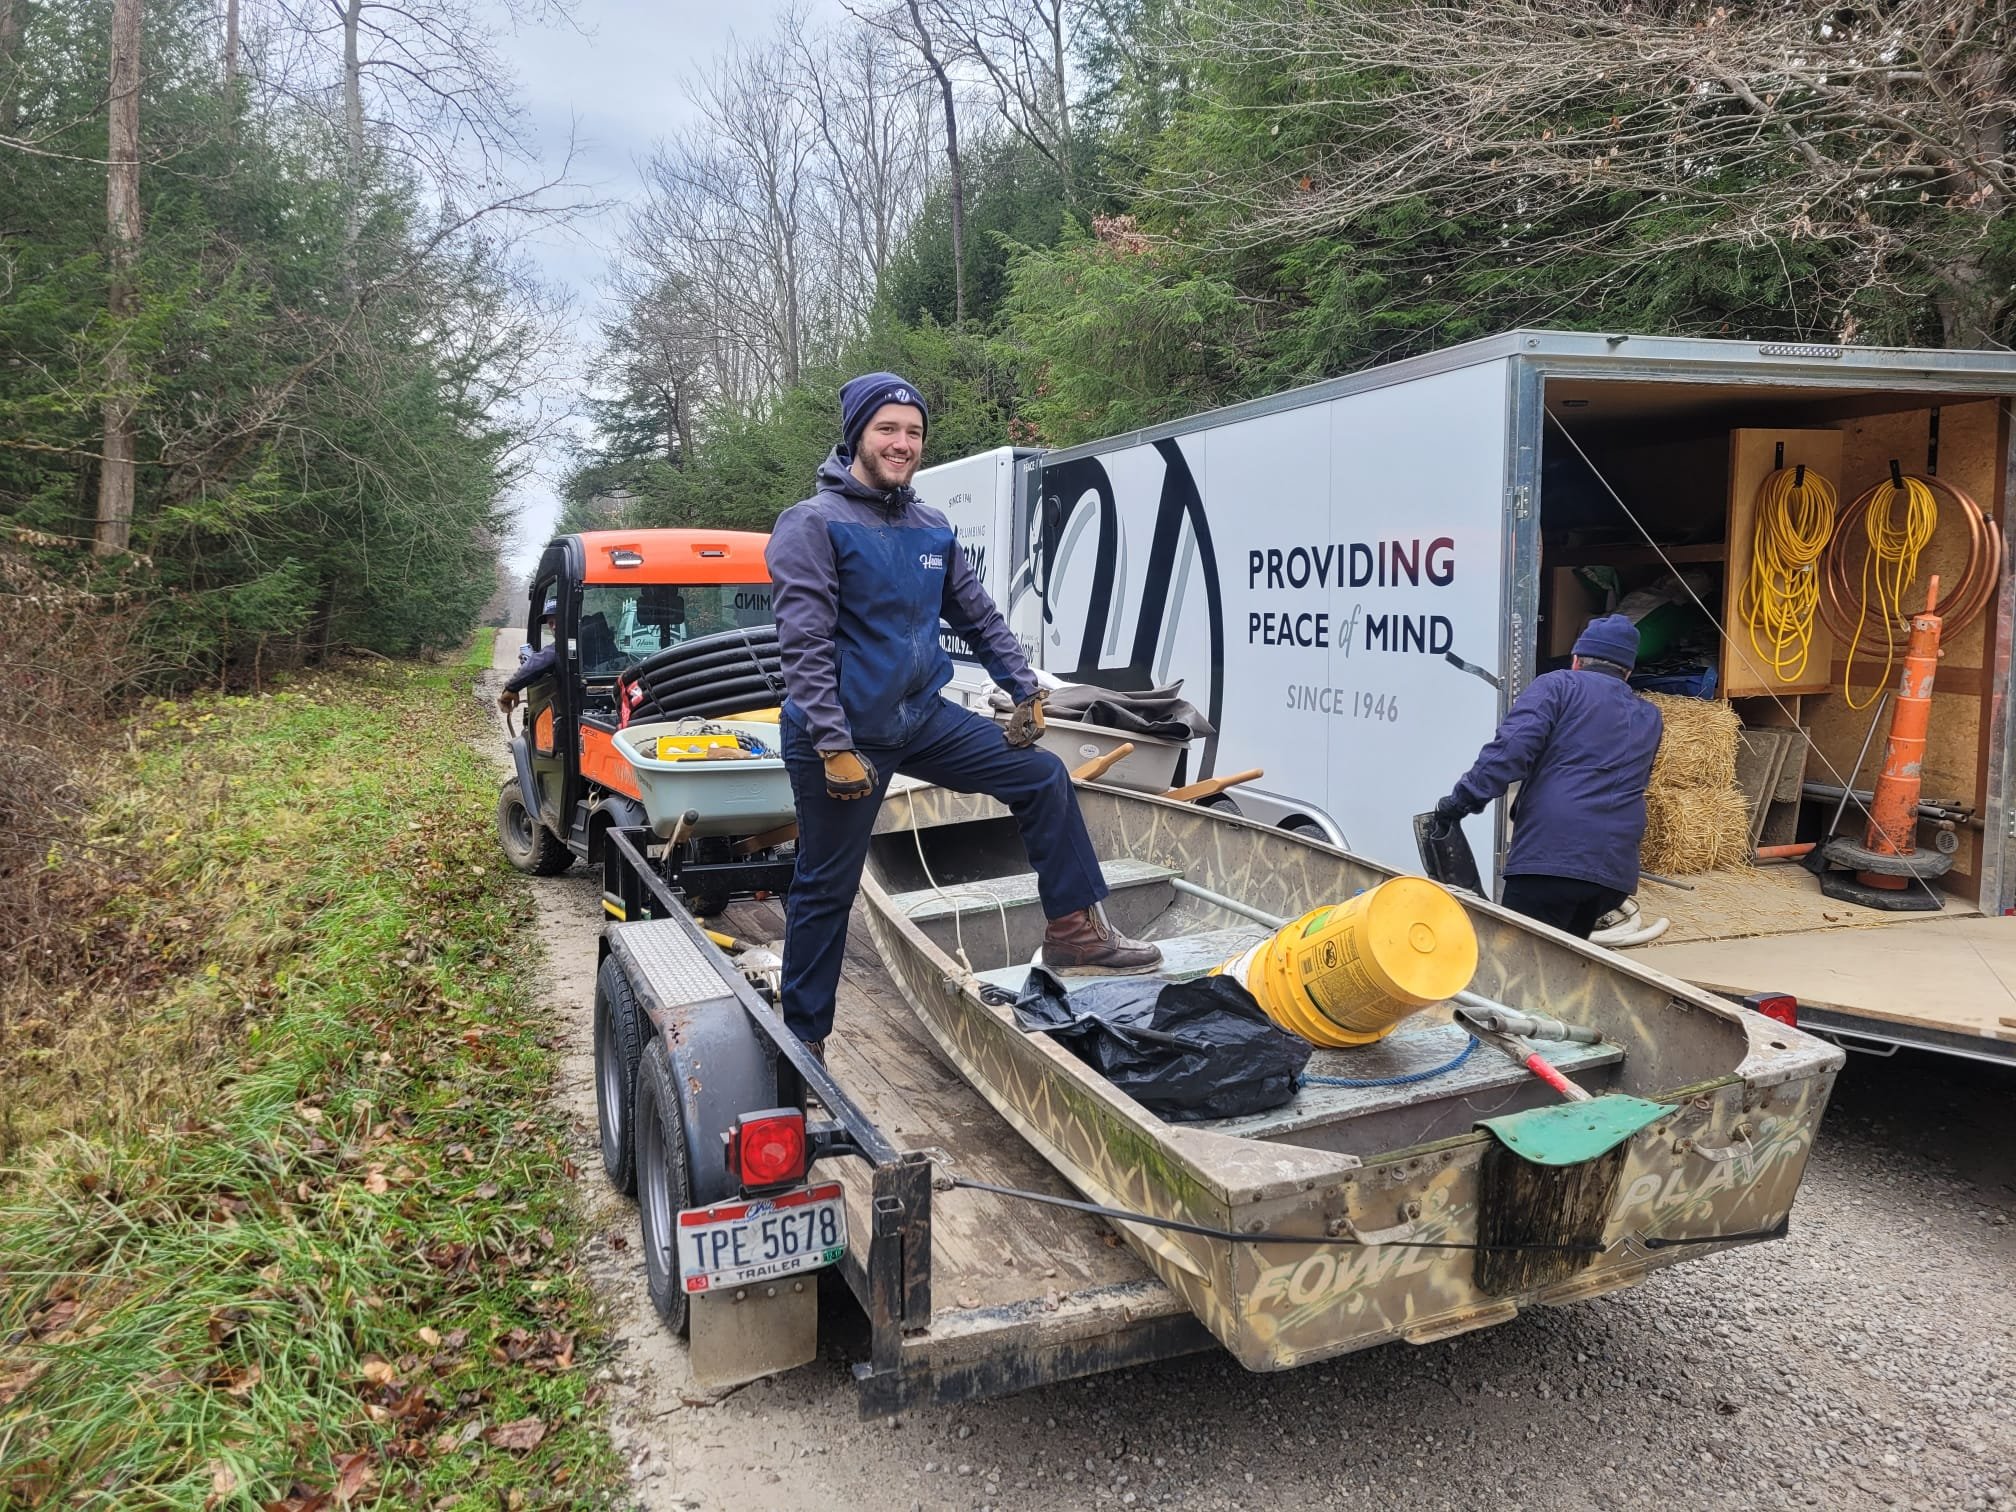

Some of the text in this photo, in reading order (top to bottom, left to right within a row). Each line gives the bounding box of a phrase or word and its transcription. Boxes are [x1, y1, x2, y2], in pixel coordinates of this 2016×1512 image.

[958, 525, 986, 539] PLUMBING
[1249, 537, 1455, 589] PROVIDING
[1249, 603, 1453, 658] PEACE of MIND
[1286, 684, 1399, 722] SINCE 1946
[691, 1207, 838, 1270] TPE 5678
[736, 1258, 801, 1281] TRAILER
[1247, 1232, 1433, 1319] FOWL
